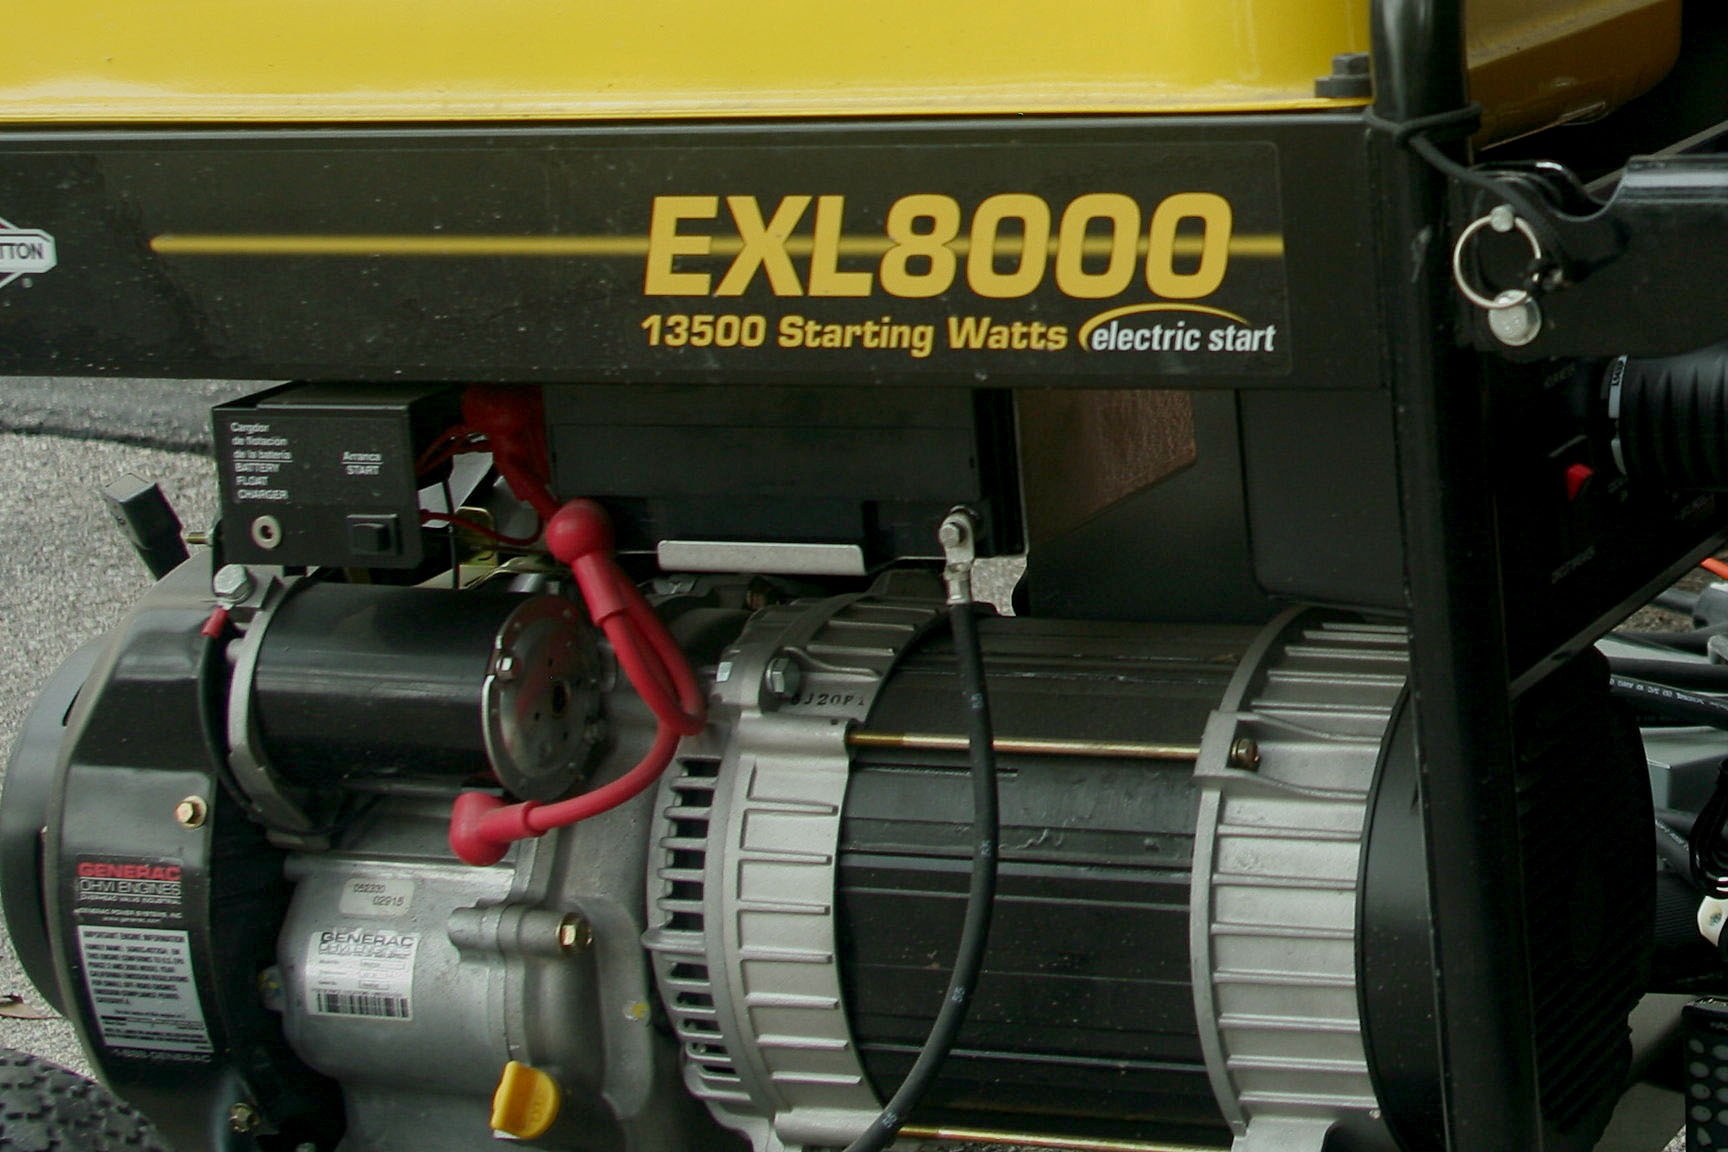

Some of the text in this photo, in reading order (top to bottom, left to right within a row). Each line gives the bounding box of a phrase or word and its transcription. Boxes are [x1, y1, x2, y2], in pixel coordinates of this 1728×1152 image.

[643, 193, 1234, 299] EXL8000
[640, 314, 1068, 359] 13500 Starting Watts
[1090, 320, 1277, 352] electric start
[235, 463, 280, 472] BATTERY
[346, 465, 379, 475] START
[235, 475, 269, 486] FLOAT
[237, 489, 289, 500] CHARGER
[77, 862, 181, 881] GENERAC
[117, 882, 182, 897] ENGINES
[321, 931, 414, 947] GENERAC
